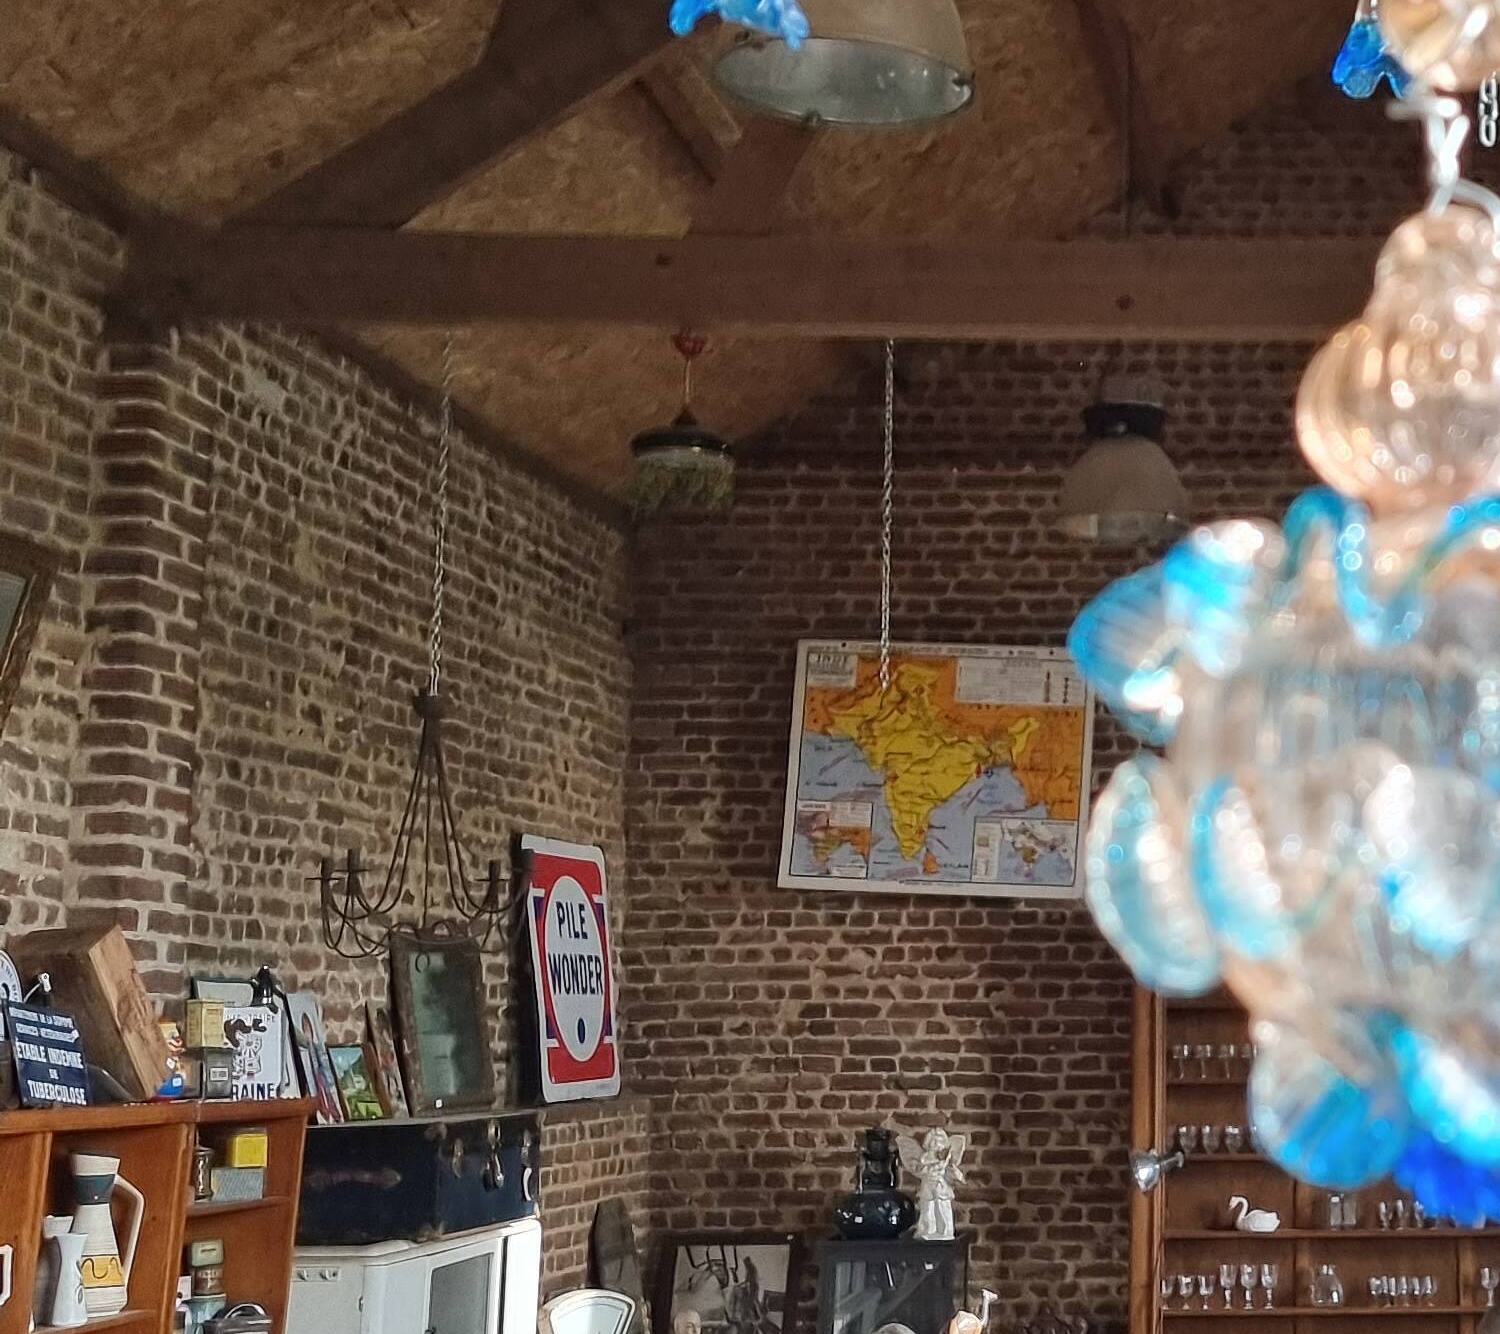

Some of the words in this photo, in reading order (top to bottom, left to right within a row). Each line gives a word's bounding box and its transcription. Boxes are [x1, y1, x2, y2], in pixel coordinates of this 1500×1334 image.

[556, 901, 588, 939] PILE
[548, 952, 604, 996] WONDER
[27, 1080, 87, 1106] TUBERCULOSE
[232, 1082, 277, 1101] RAINE
